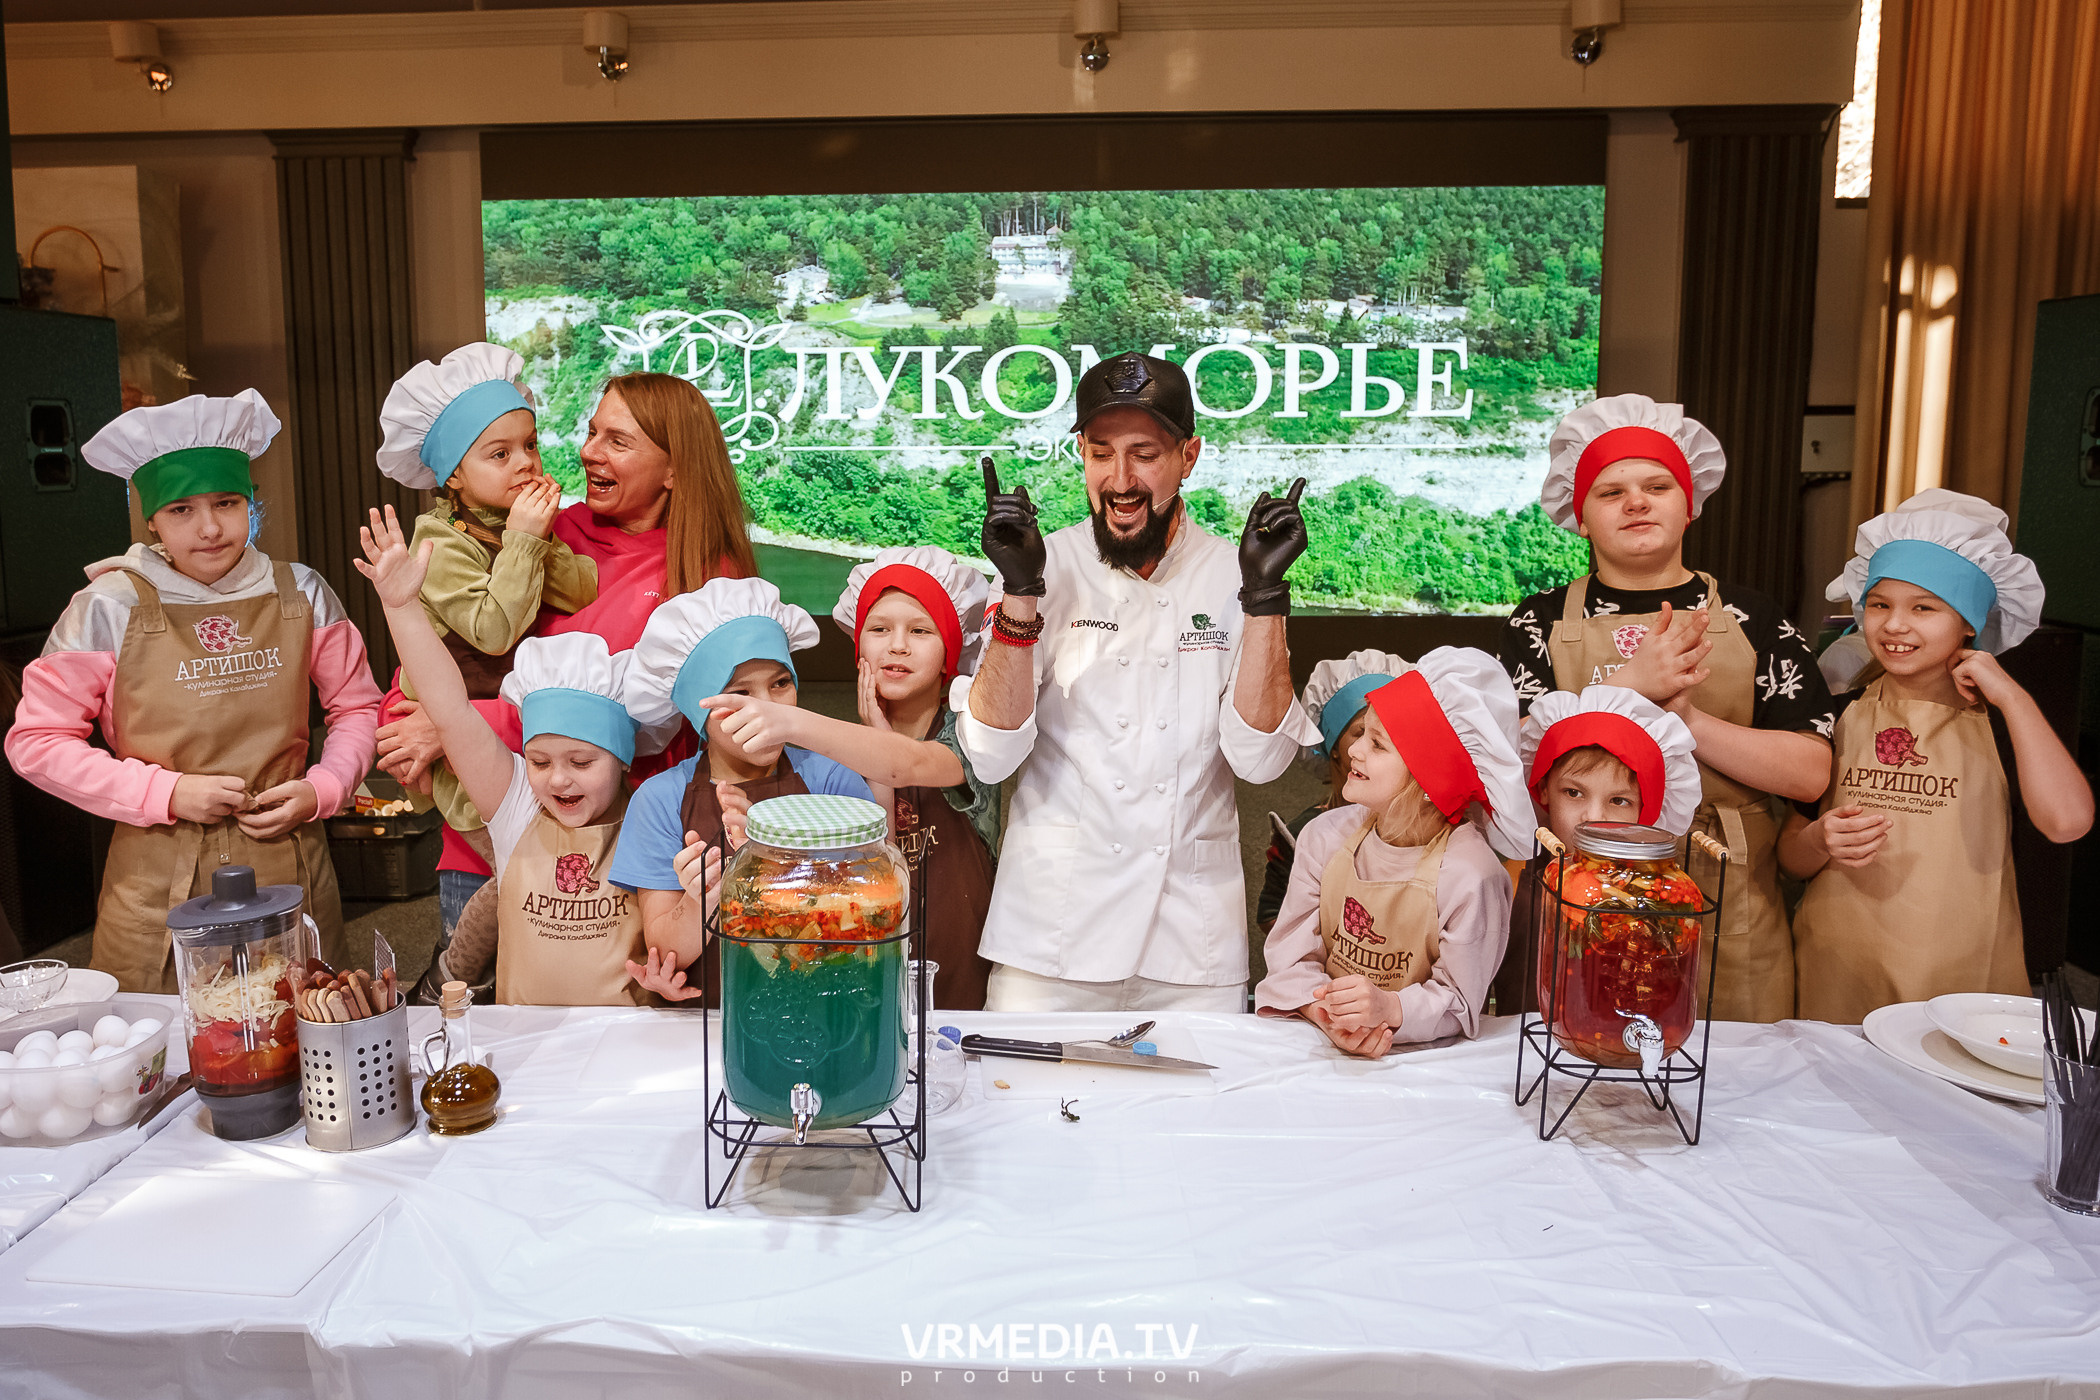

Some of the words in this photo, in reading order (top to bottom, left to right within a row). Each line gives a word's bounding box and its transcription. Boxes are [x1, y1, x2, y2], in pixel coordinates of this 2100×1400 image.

[1070, 619, 1119, 632] KENWOOD
[1179, 630, 1229, 642] АРТИШОК
[175, 647, 282, 681] АРТИШОК
[1840, 767, 1959, 798] АРТИШОК
[522, 891, 629, 921] АРТИШОК
